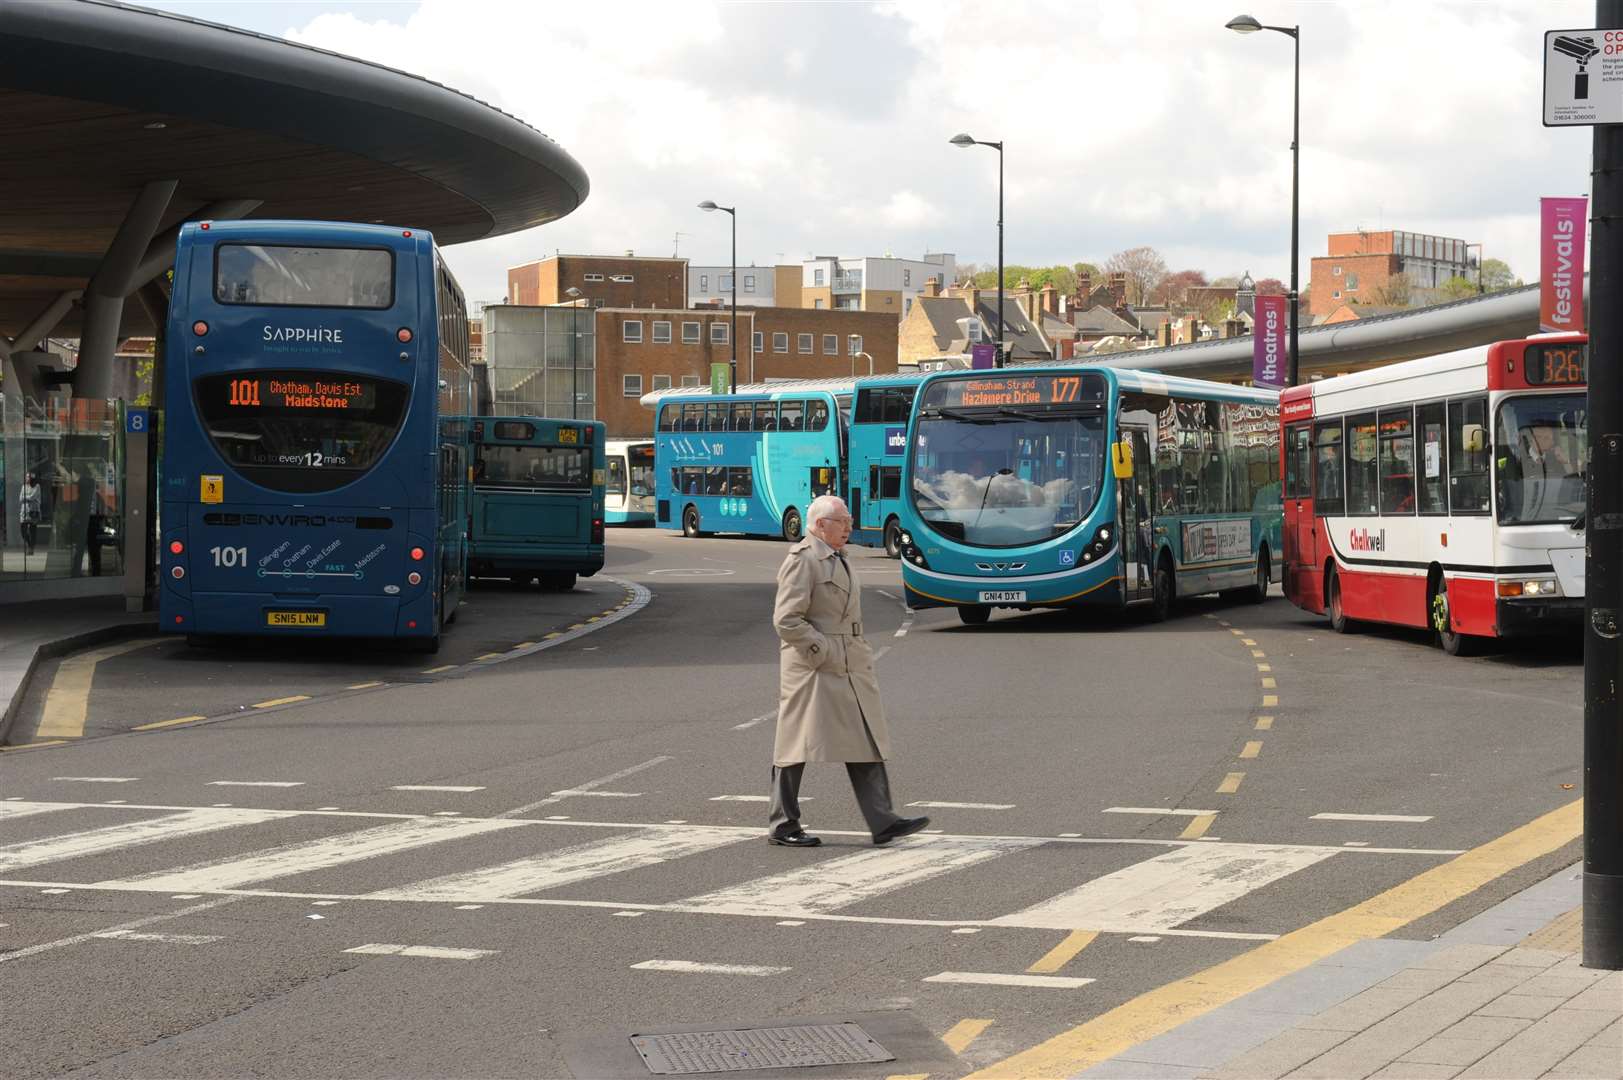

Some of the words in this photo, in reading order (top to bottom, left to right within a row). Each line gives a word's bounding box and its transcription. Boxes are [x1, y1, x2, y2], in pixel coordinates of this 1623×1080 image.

[1552, 220, 1574, 324] festivals
[1262, 310, 1277, 380] theatres
[230, 380, 260, 405] 101
[315, 382, 341, 395] Davis
[962, 391, 1011, 405] Hazlemere
[1014, 390, 1040, 404] Drive
[1007, 379, 1036, 390] Strand
[1051, 377, 1080, 402] 177
[285, 394, 348, 408] Maidstone
[132, 415, 143, 430] 8
[279, 455, 304, 465] every
[304, 452, 323, 467] 12
[323, 452, 346, 464] mins
[712, 443, 723, 456] 101
[1350, 528, 1385, 552] Chalkwell
[210, 546, 248, 567] 101
[259, 540, 290, 567] Gillingham
[284, 543, 312, 568] Chatham
[306, 551, 325, 569] Davis
[320, 539, 341, 557] Estate
[354, 543, 386, 569] Maidstone
[325, 564, 344, 572] FAST
[984, 592, 1002, 601] GN14
[1004, 592, 1021, 601] DXT
[274, 613, 297, 625] SN15
[300, 613, 319, 625] LNM
